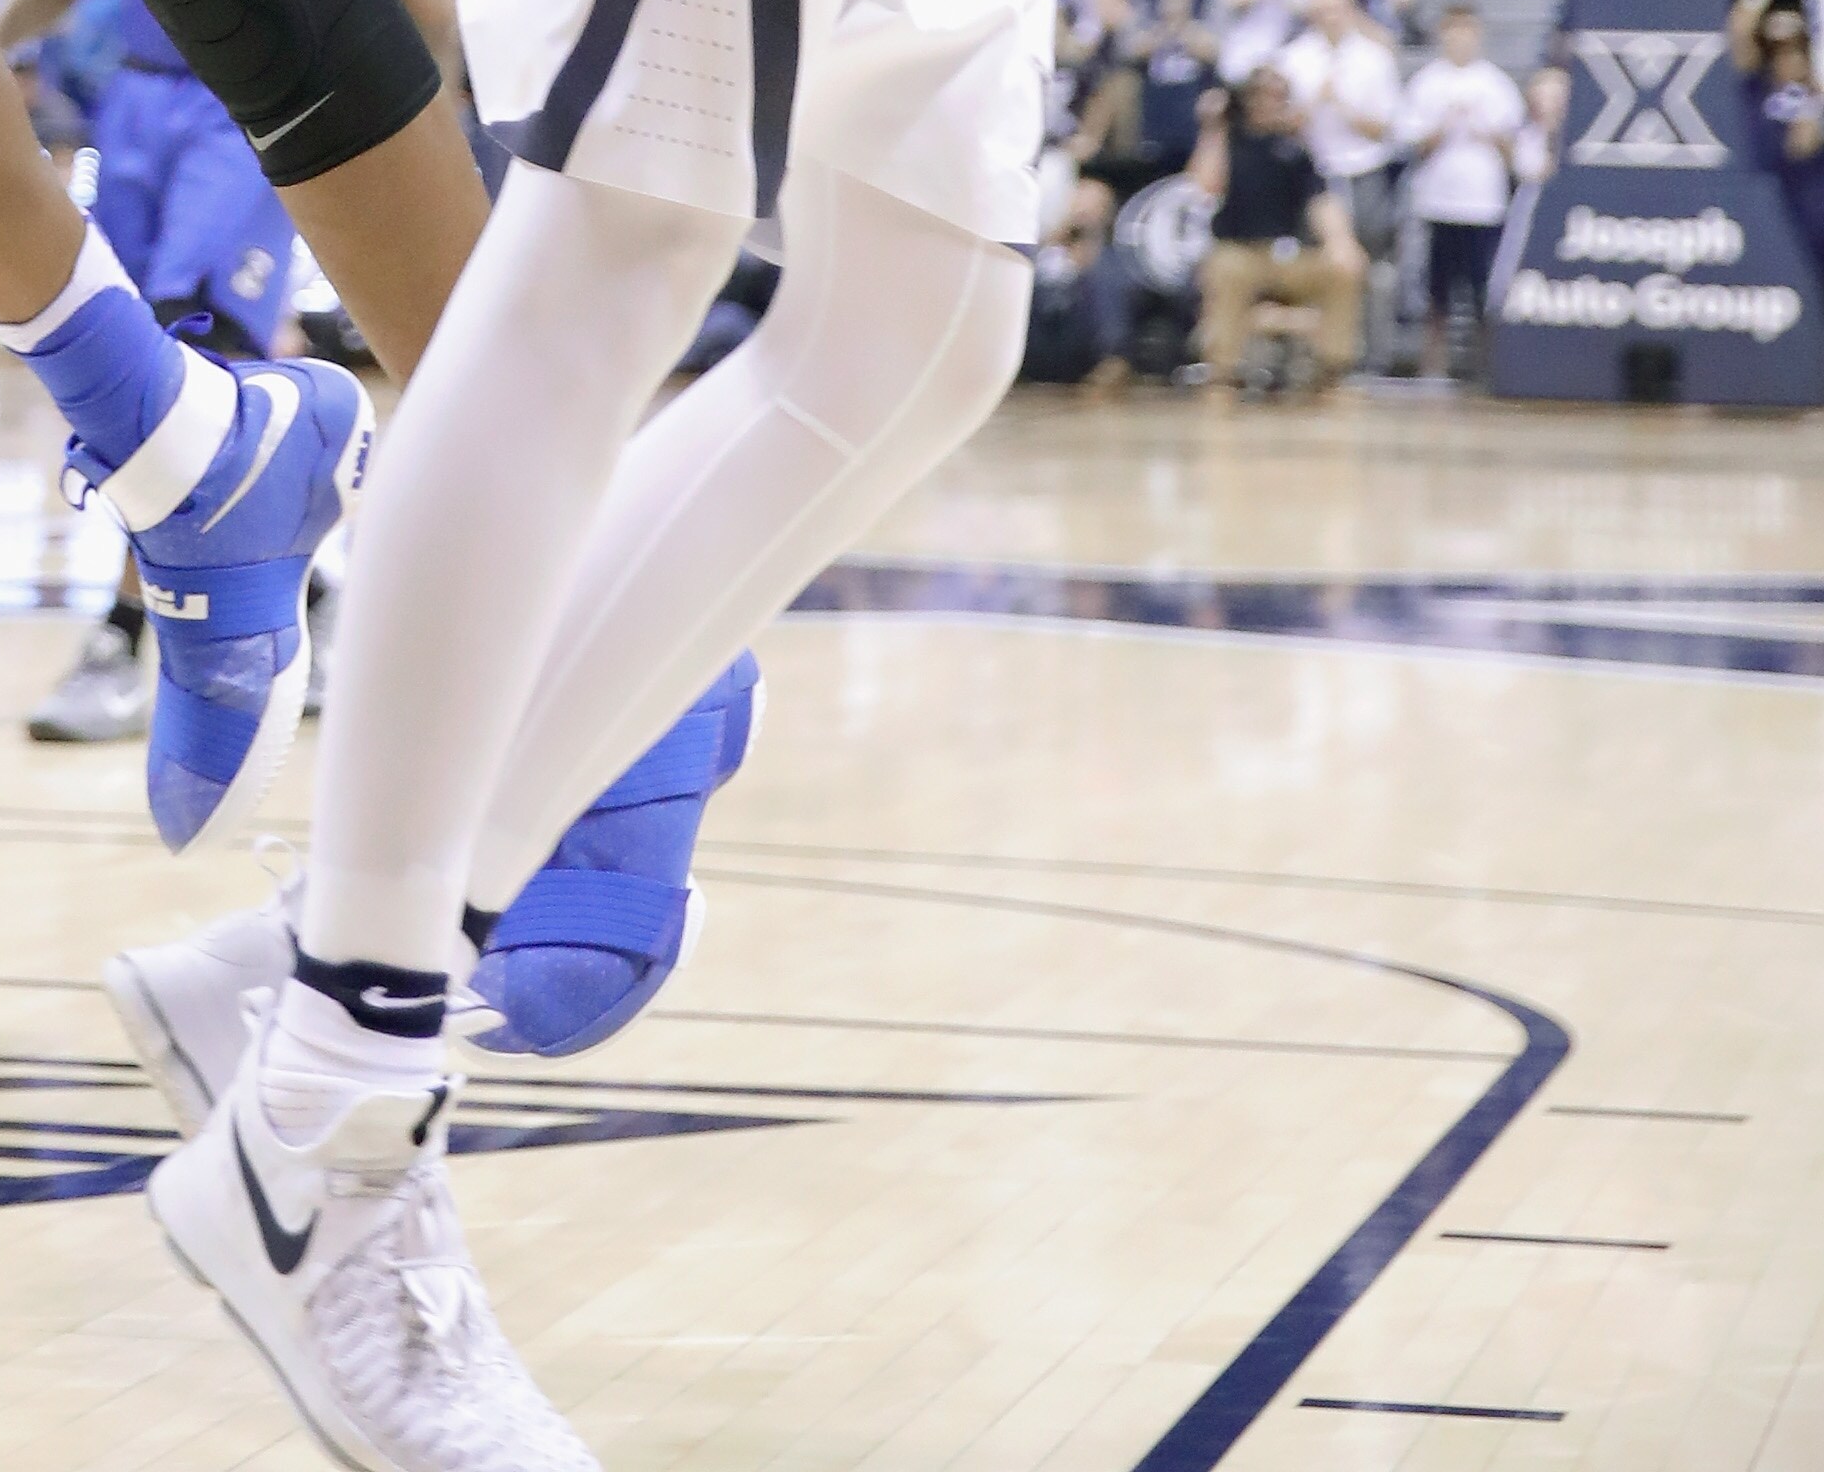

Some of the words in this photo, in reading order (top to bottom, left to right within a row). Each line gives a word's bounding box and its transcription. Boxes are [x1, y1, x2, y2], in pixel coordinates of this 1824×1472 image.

[1556, 205, 1745, 273] Joseph
[1503, 268, 1633, 329] Auto
[1633, 273, 1802, 342] Group
